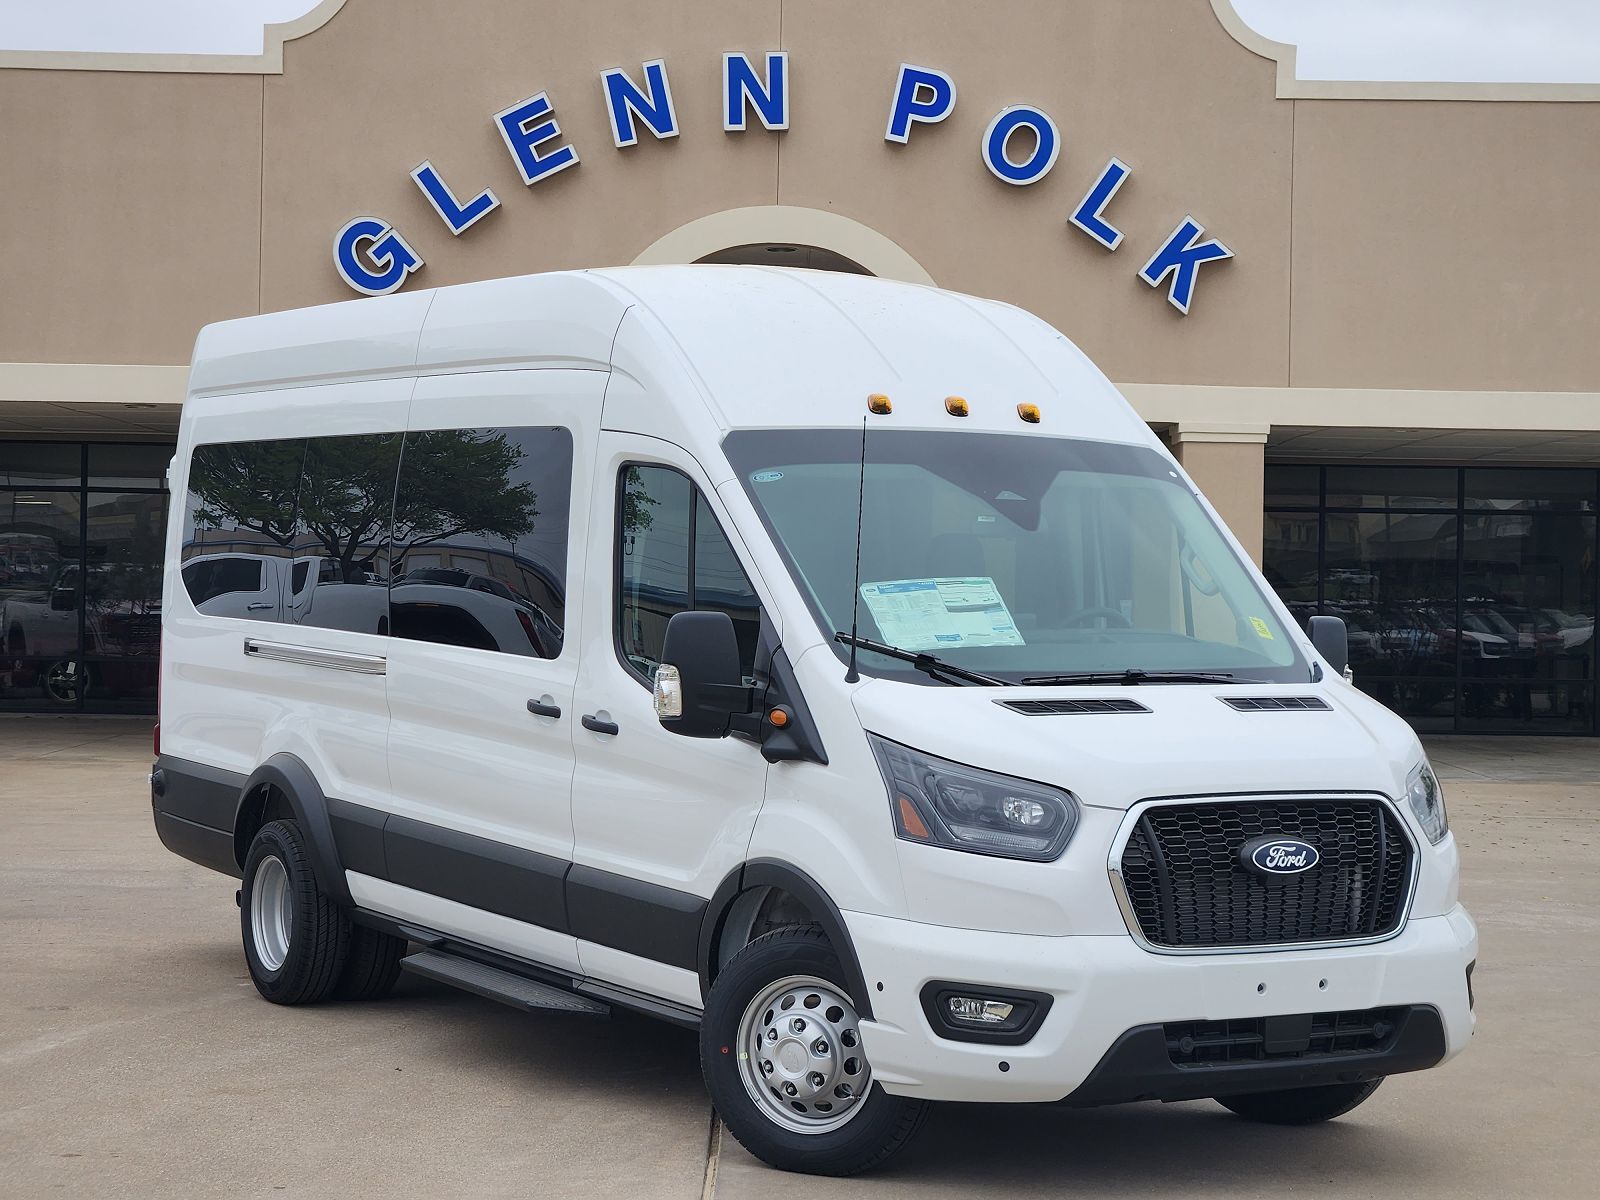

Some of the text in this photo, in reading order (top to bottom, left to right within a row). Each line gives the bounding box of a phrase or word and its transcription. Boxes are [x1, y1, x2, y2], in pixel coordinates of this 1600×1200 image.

[333, 51, 1236, 316] GLENN POLK
[1266, 846, 1307, 868] Ford
